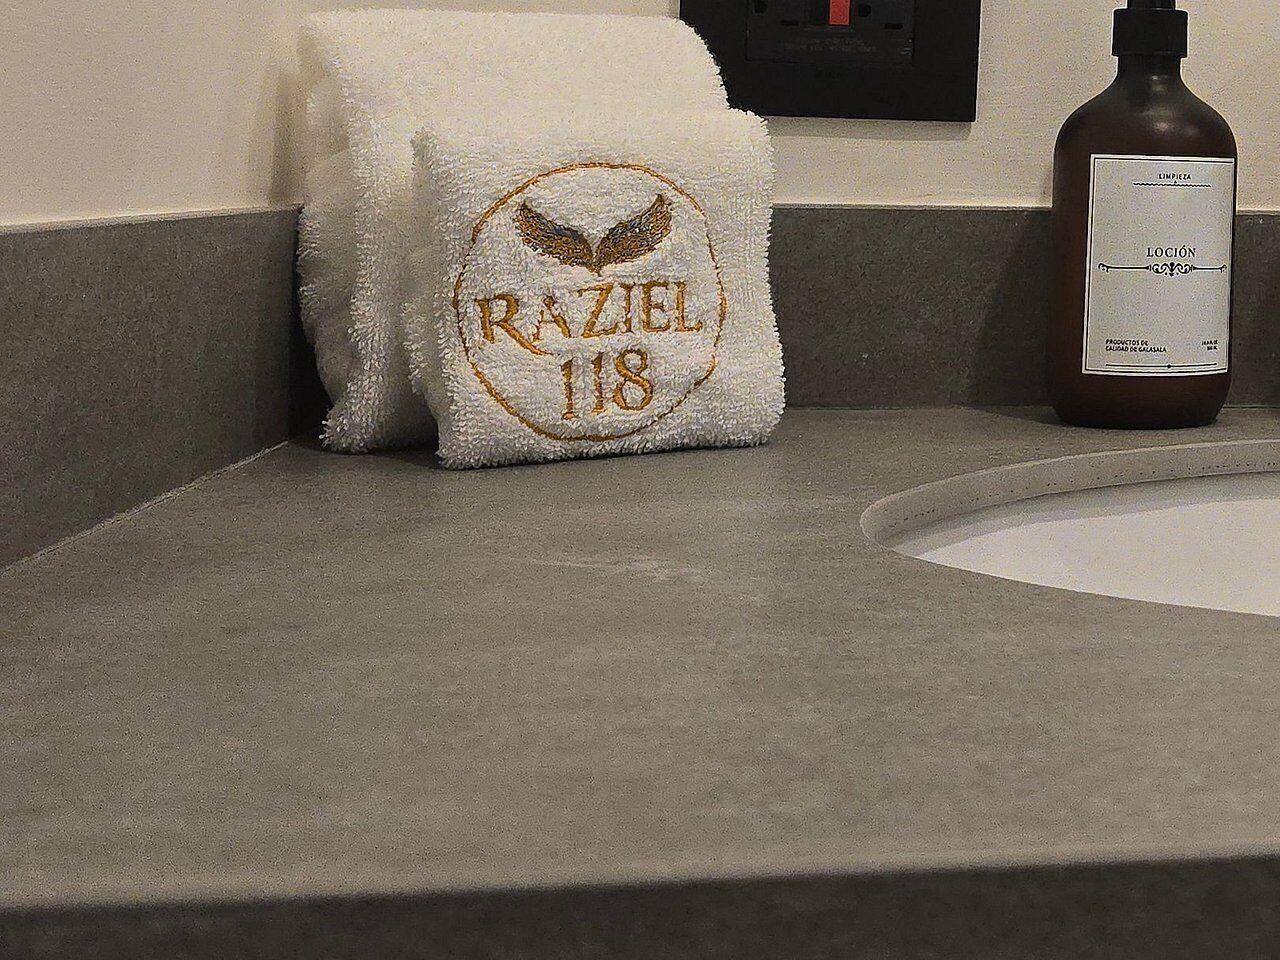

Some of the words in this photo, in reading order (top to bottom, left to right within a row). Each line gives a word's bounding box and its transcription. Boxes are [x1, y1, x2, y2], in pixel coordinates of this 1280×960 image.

[1146, 244, 1196, 258] LOCIÓN
[474, 280, 703, 356] RAZIEL
[560, 348, 654, 421] 118
